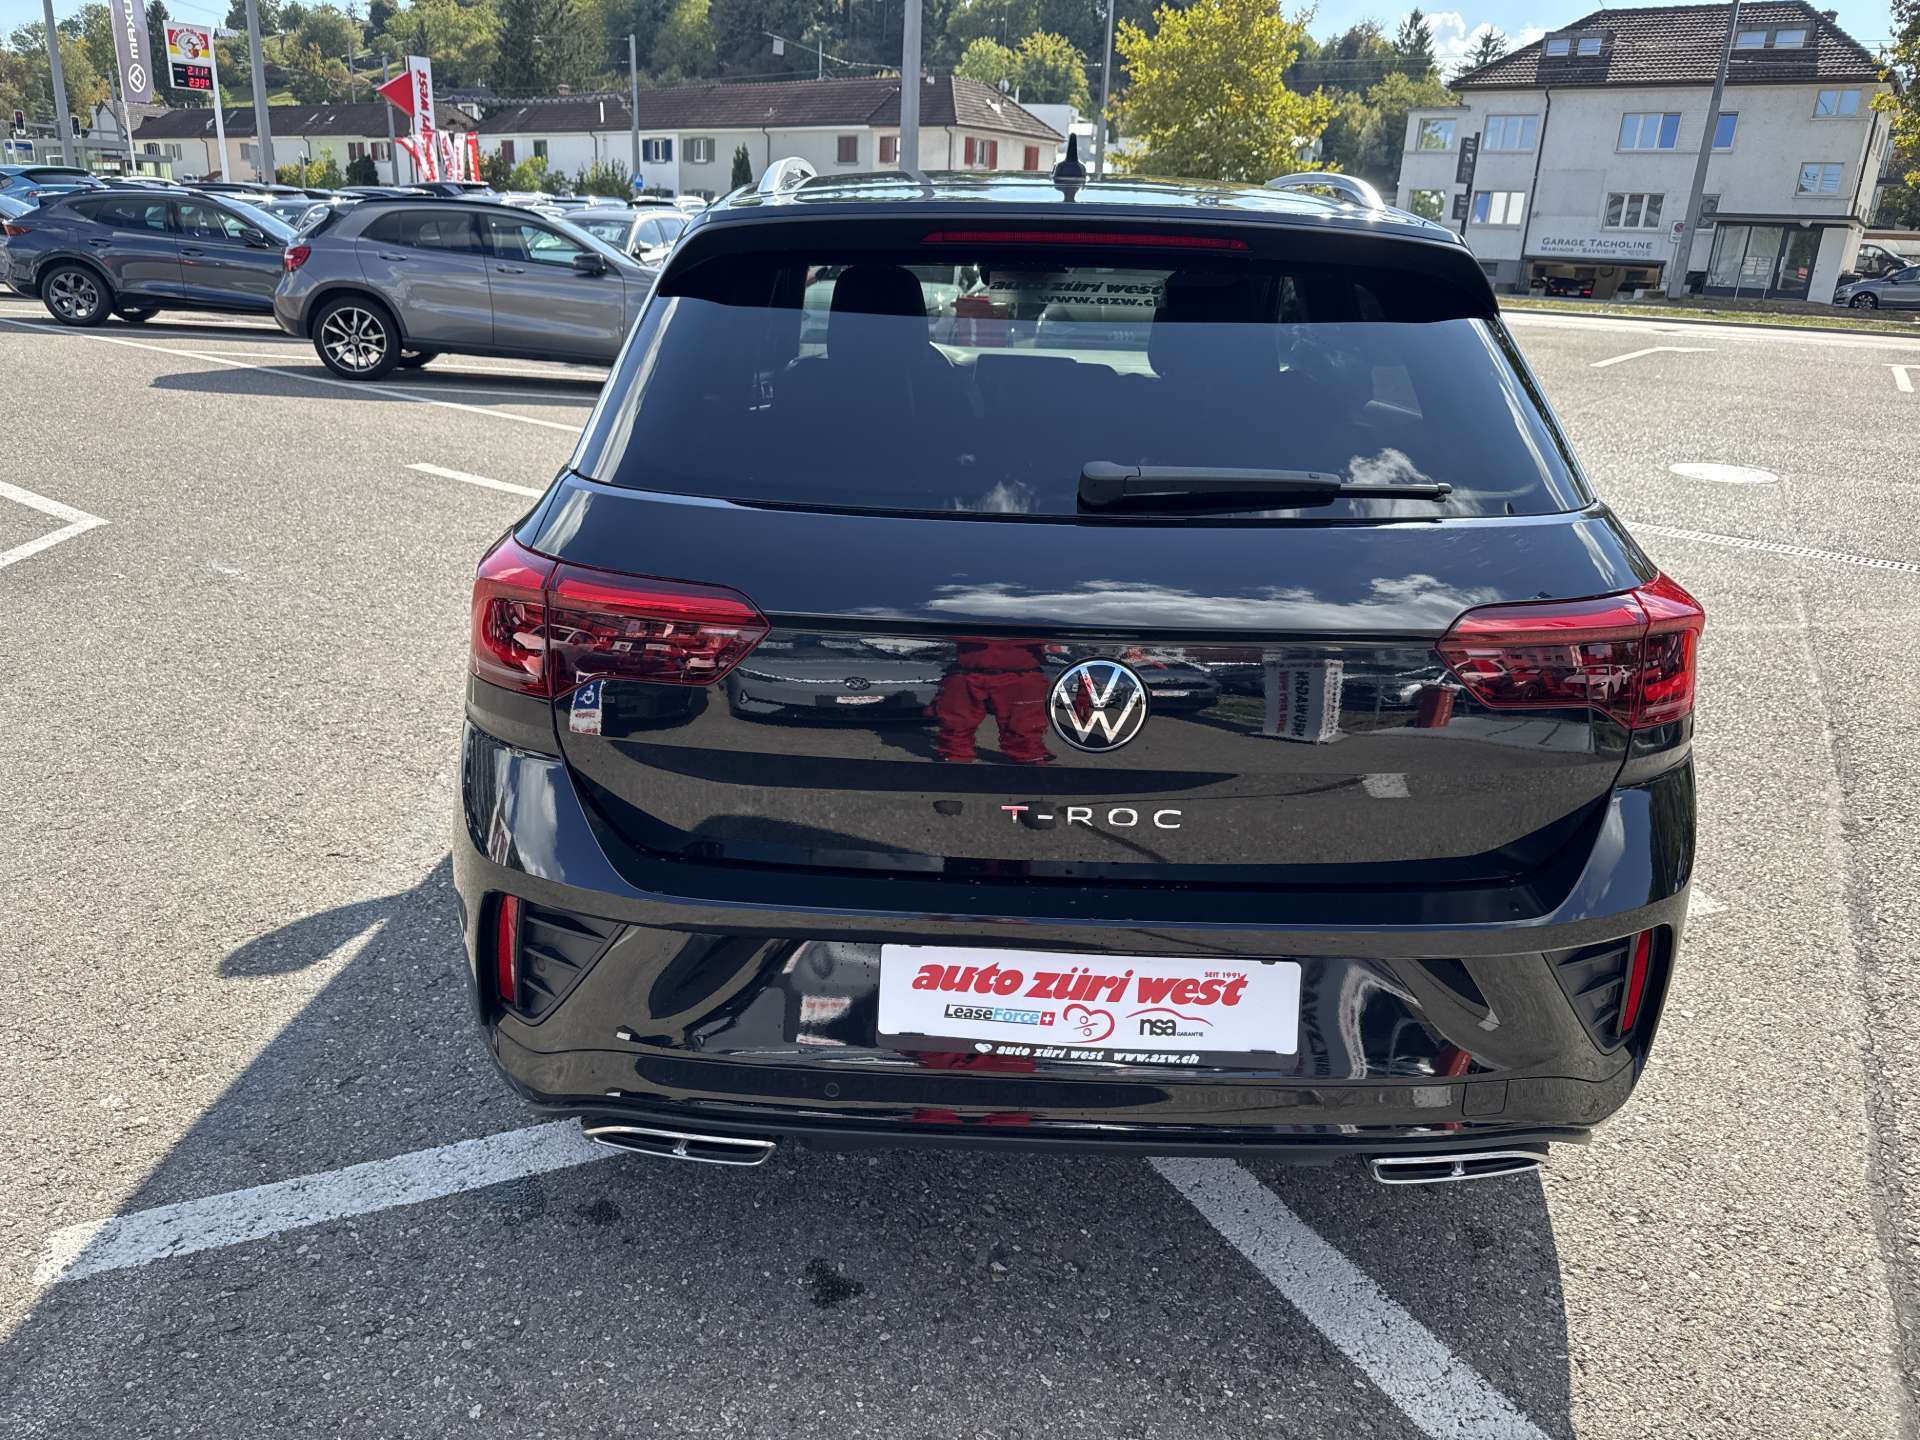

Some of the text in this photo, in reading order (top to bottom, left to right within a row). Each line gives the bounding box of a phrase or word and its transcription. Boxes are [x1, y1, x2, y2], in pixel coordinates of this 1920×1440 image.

[1542, 237, 1653, 250] GARAGE TACHOLINE
[1052, 278, 1104, 293] züri
[1000, 804, 1183, 830] T-ROC
[911, 962, 1249, 1007] auto züri west
[944, 1003, 1040, 1026] LeaseForce
[1139, 1018, 1177, 1037] nsa
[996, 1045, 1200, 1065] auto züri west www.azw.ch
